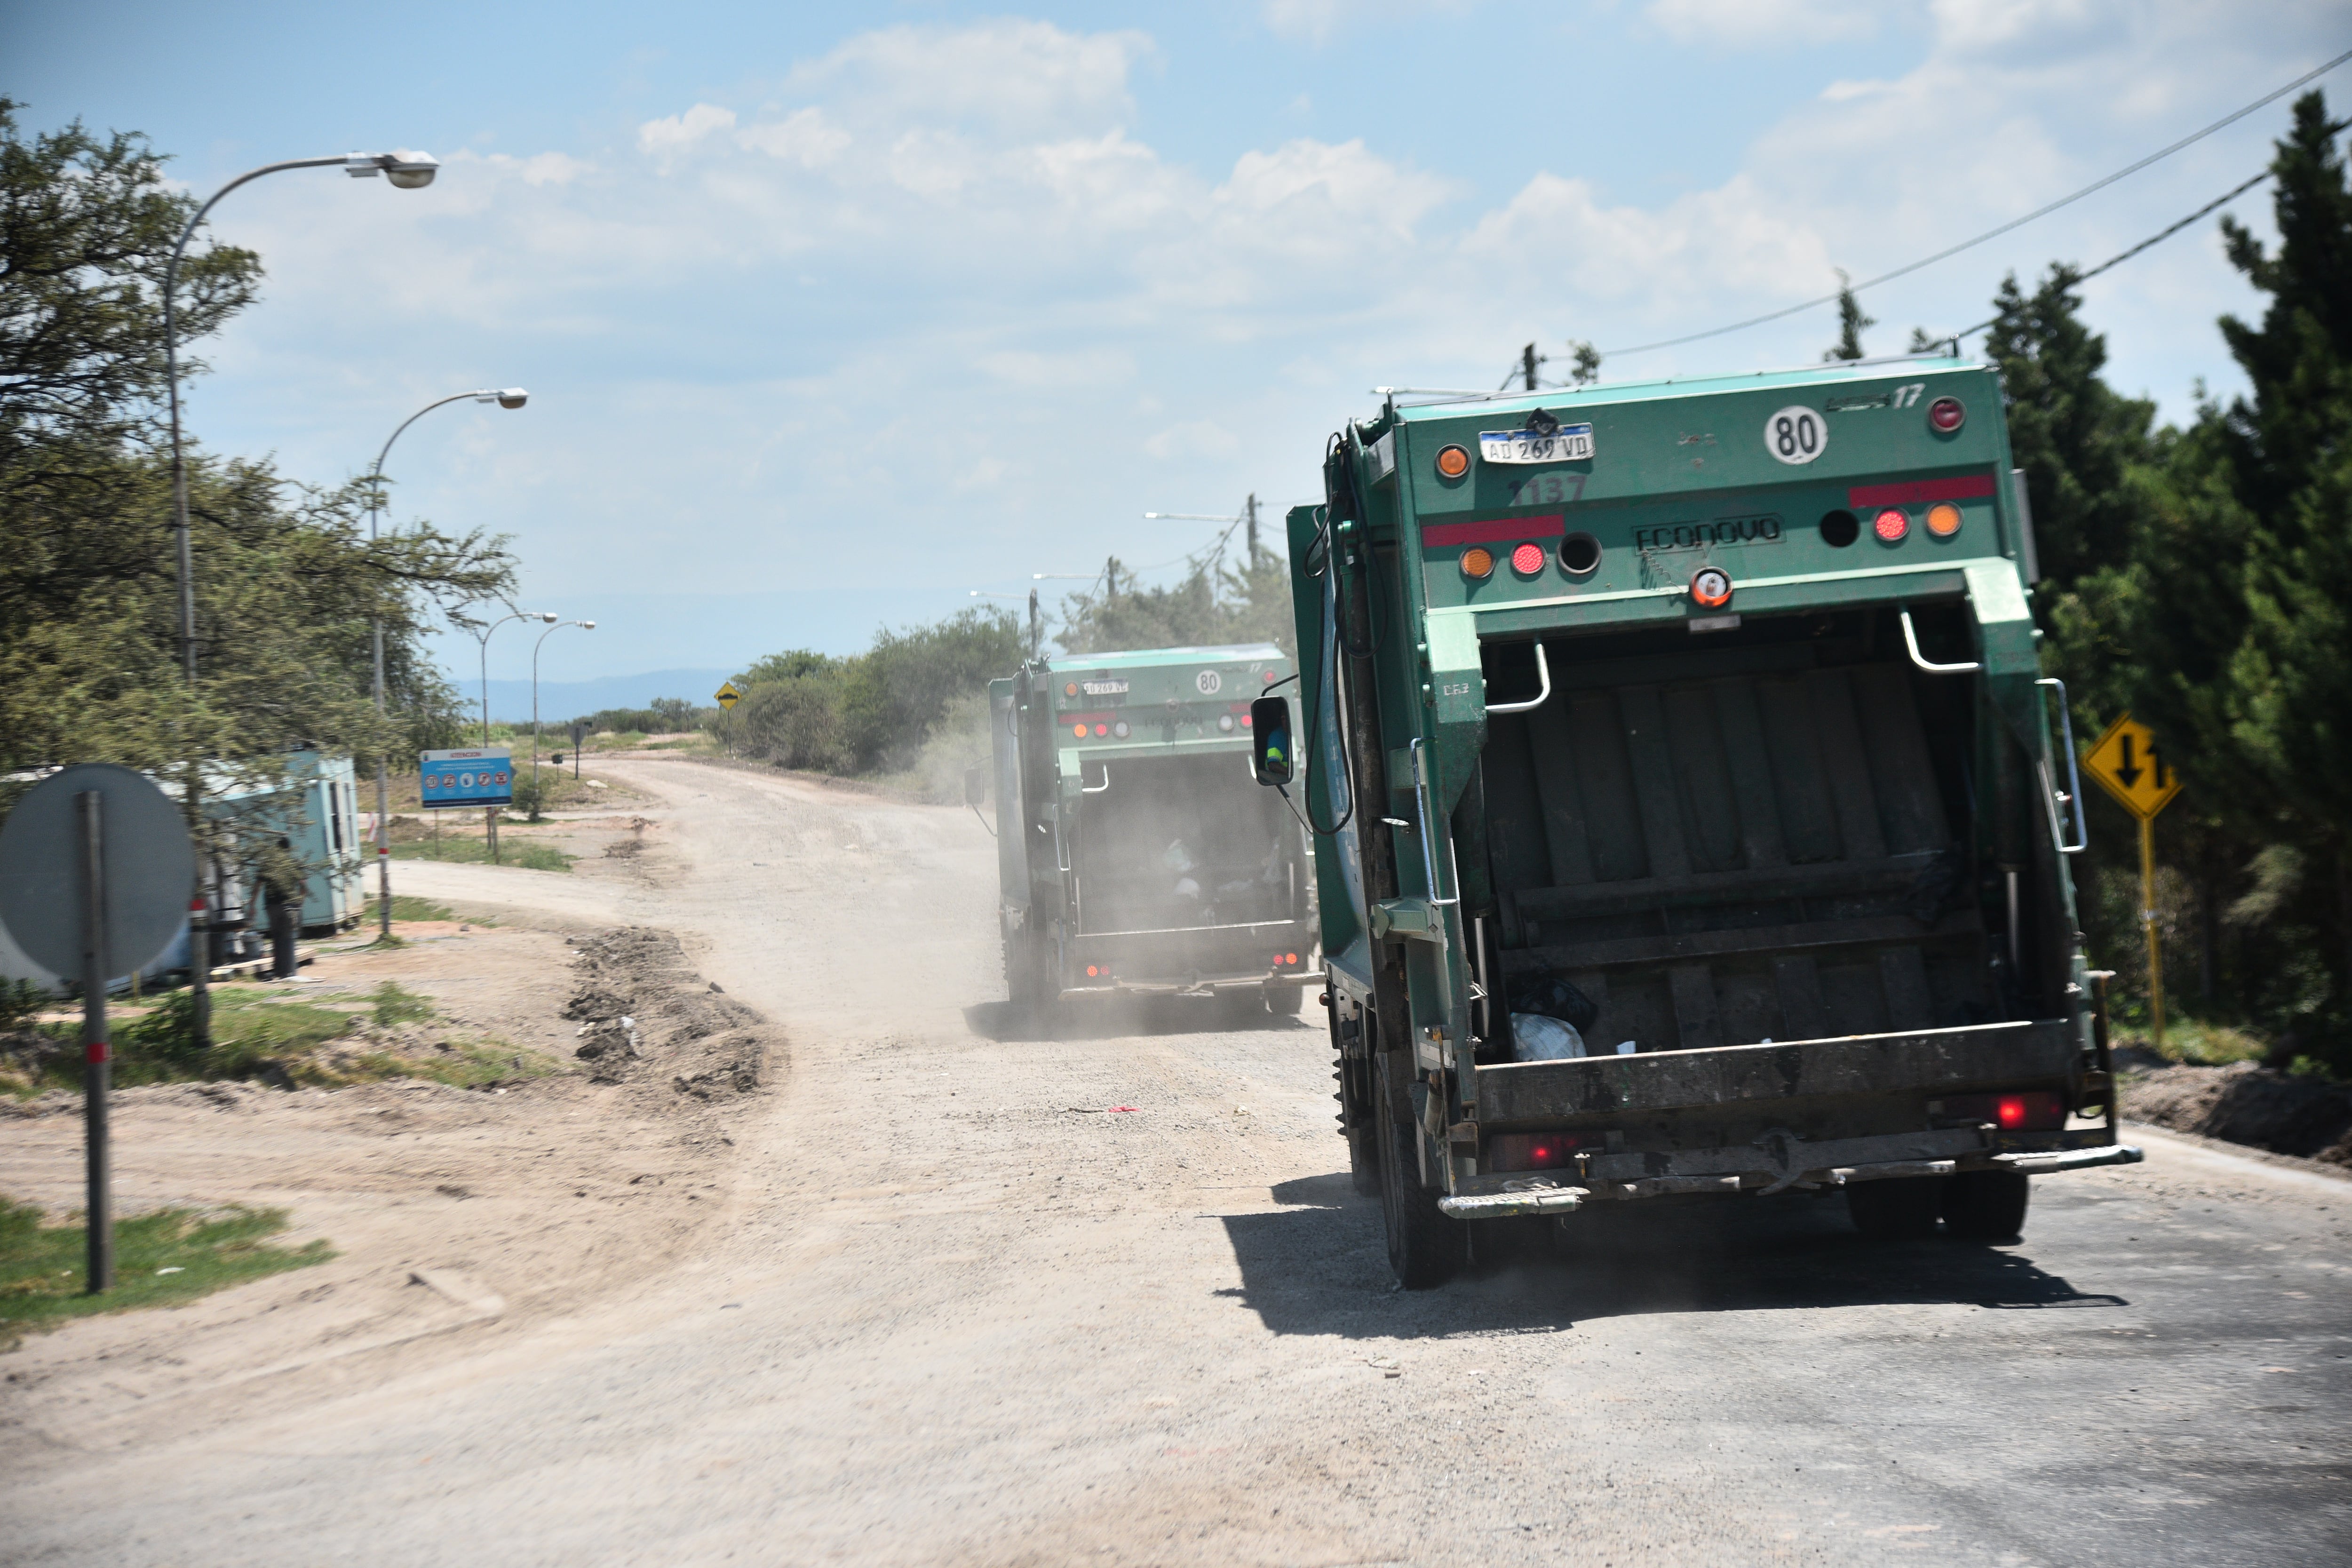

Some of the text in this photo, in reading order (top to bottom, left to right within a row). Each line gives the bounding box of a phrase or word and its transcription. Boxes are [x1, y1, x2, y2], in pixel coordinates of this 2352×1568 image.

[1892, 382, 1926, 410] 17
[1490, 434, 1588, 460] AD 269 VD
[1777, 414, 1817, 456] 80
[1507, 475, 1587, 505] 1137
[1201, 674, 1217, 691] 80
